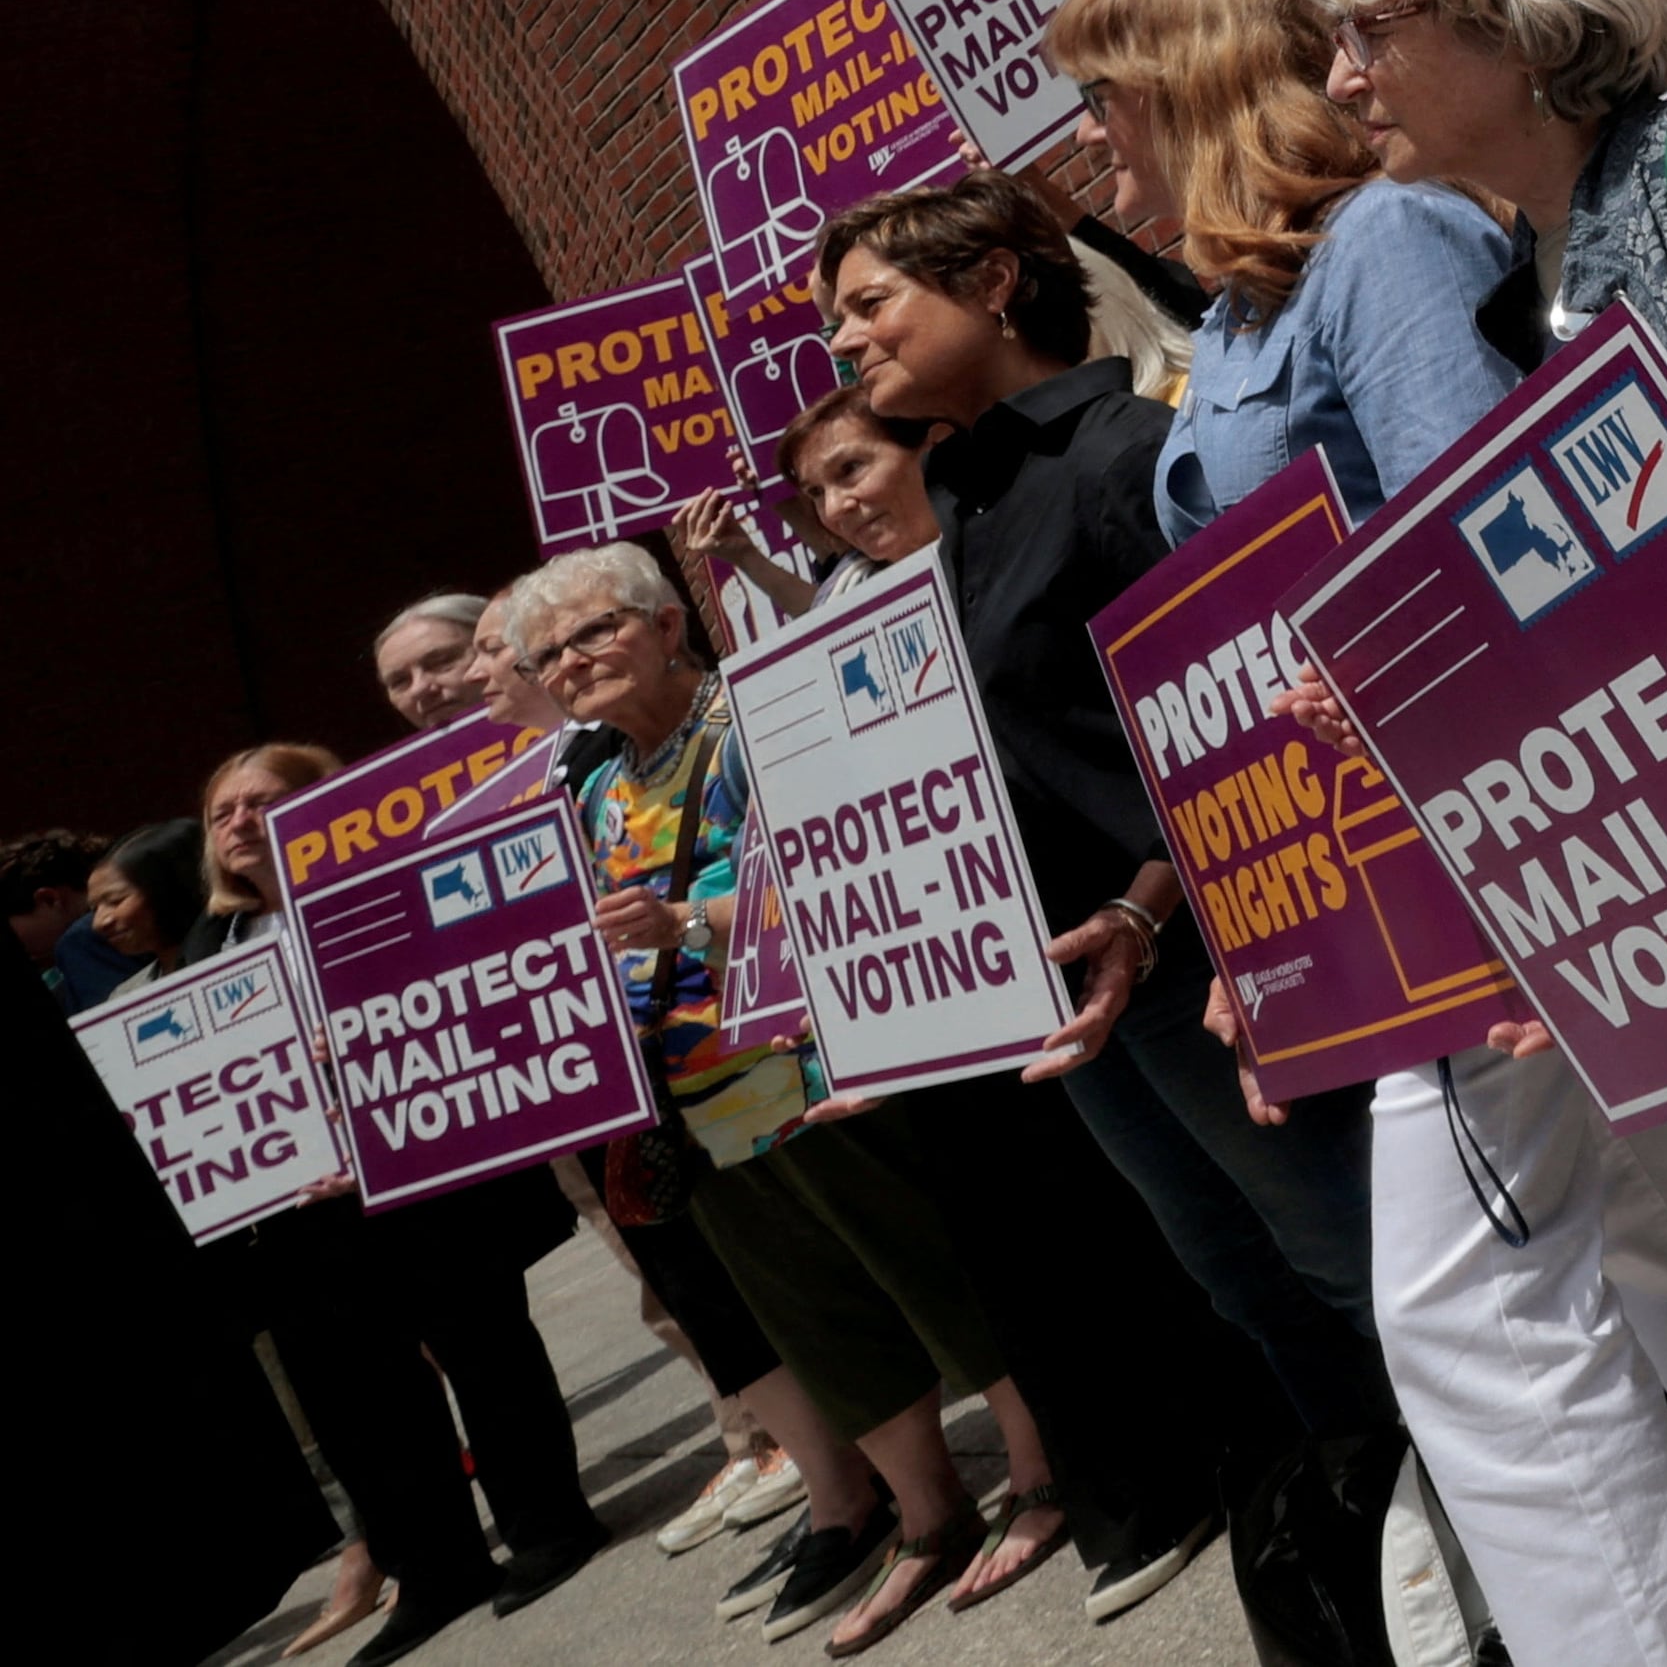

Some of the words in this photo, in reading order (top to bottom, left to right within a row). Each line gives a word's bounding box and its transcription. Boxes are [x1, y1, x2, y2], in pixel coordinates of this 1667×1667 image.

[791, 28, 917, 127] MAIL-I
[802, 71, 941, 176] VOTING
[975, 42, 1060, 117] VOT
[651, 407, 735, 454] VOT
[1563, 407, 1646, 507] LWV
[891, 619, 929, 675] LWV
[1135, 610, 1310, 781] PROTEC
[773, 754, 986, 888] PROTECT
[1172, 740, 1326, 872] VOTING
[500, 835, 544, 878] LWV
[1202, 833, 1347, 953] RIGHTS
[212, 973, 256, 1013] LWV
[329, 922, 595, 1058] PROTECT
[825, 920, 1017, 1022] VOTING
[121, 1036, 298, 1132] TECT
[371, 1042, 600, 1152] VOTING
[158, 1130, 298, 1205] ING
